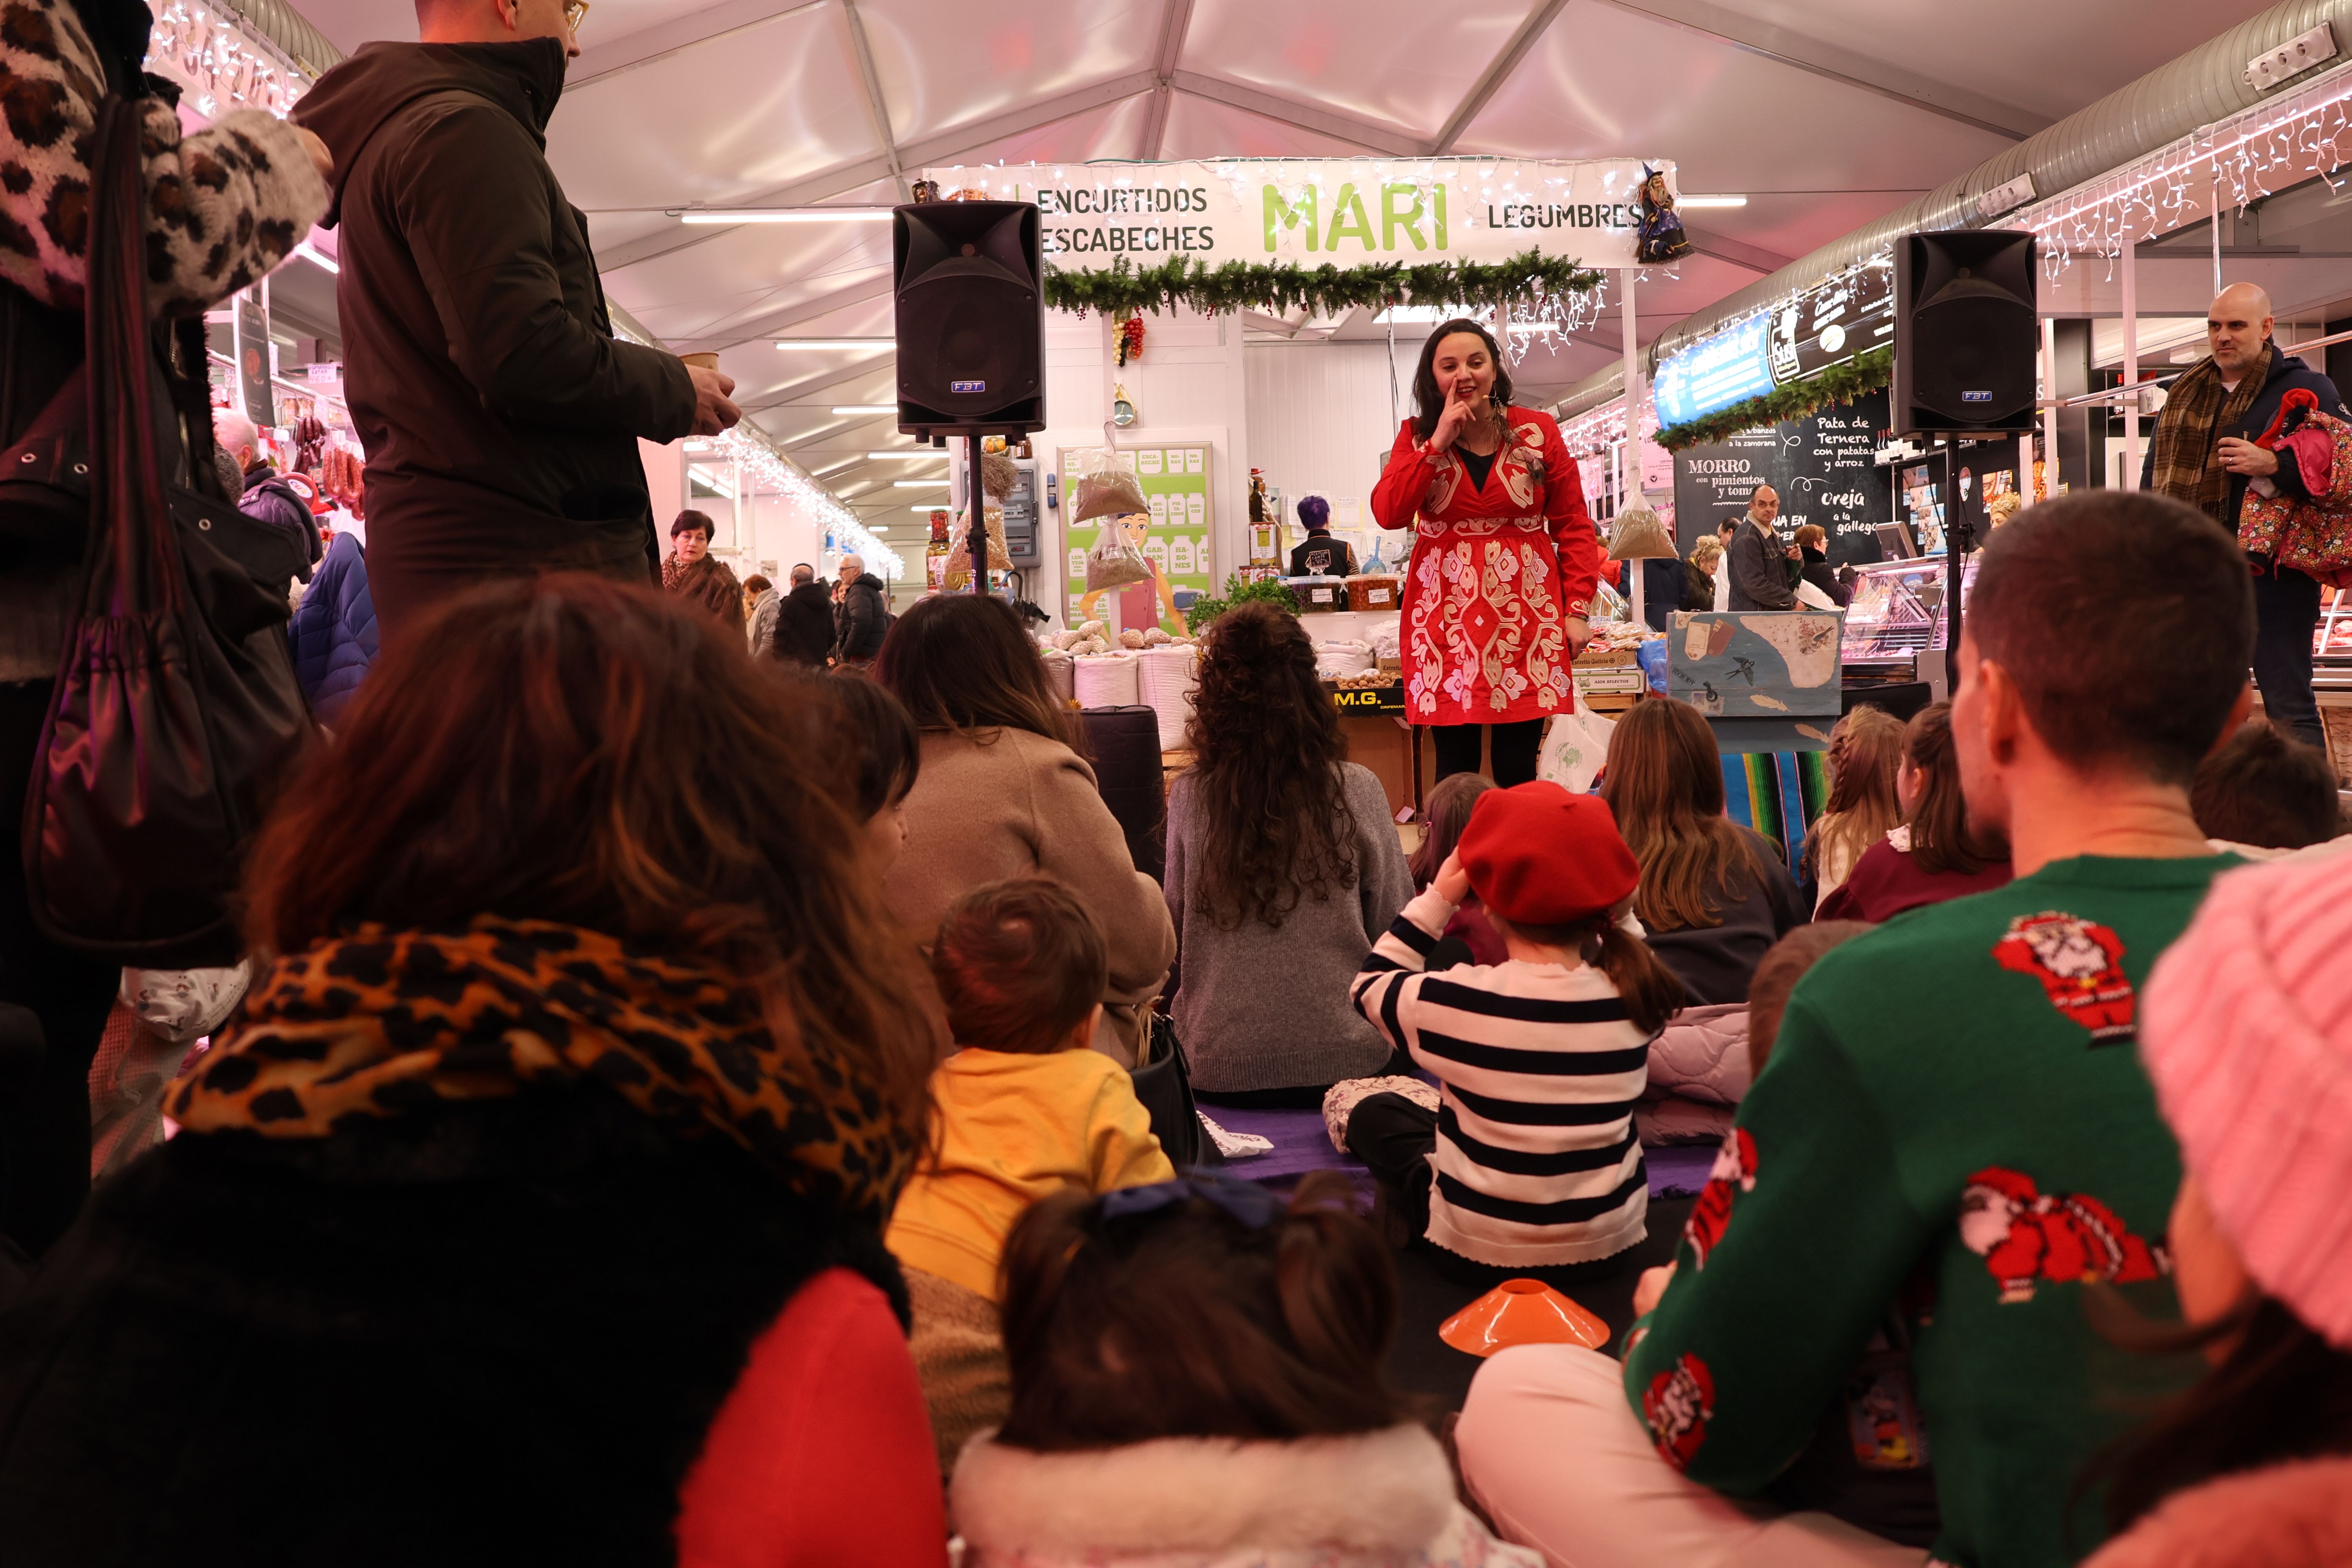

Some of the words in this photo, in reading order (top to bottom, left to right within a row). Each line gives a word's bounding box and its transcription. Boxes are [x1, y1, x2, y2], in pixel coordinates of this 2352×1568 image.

[1038, 188, 1207, 214] ENCURTIDOS
[1262, 183, 1447, 253] MARI
[1489, 205, 1642, 228] LEGUMBRES
[1042, 226, 1214, 252] ESCABECHES
[1817, 417, 1846, 429] Pata
[1852, 416, 1869, 428] de
[1817, 433, 1870, 444] Ternera
[1838, 446, 1875, 460] patatas
[1688, 459, 1750, 474] MORRO
[1824, 461, 1831, 472] y
[1711, 474, 1765, 488] pimientos
[1718, 488, 1725, 498] y
[1842, 512, 1850, 521] la
[1685, 676, 1695, 685] AIR
[1334, 692, 1381, 705] M.G.
